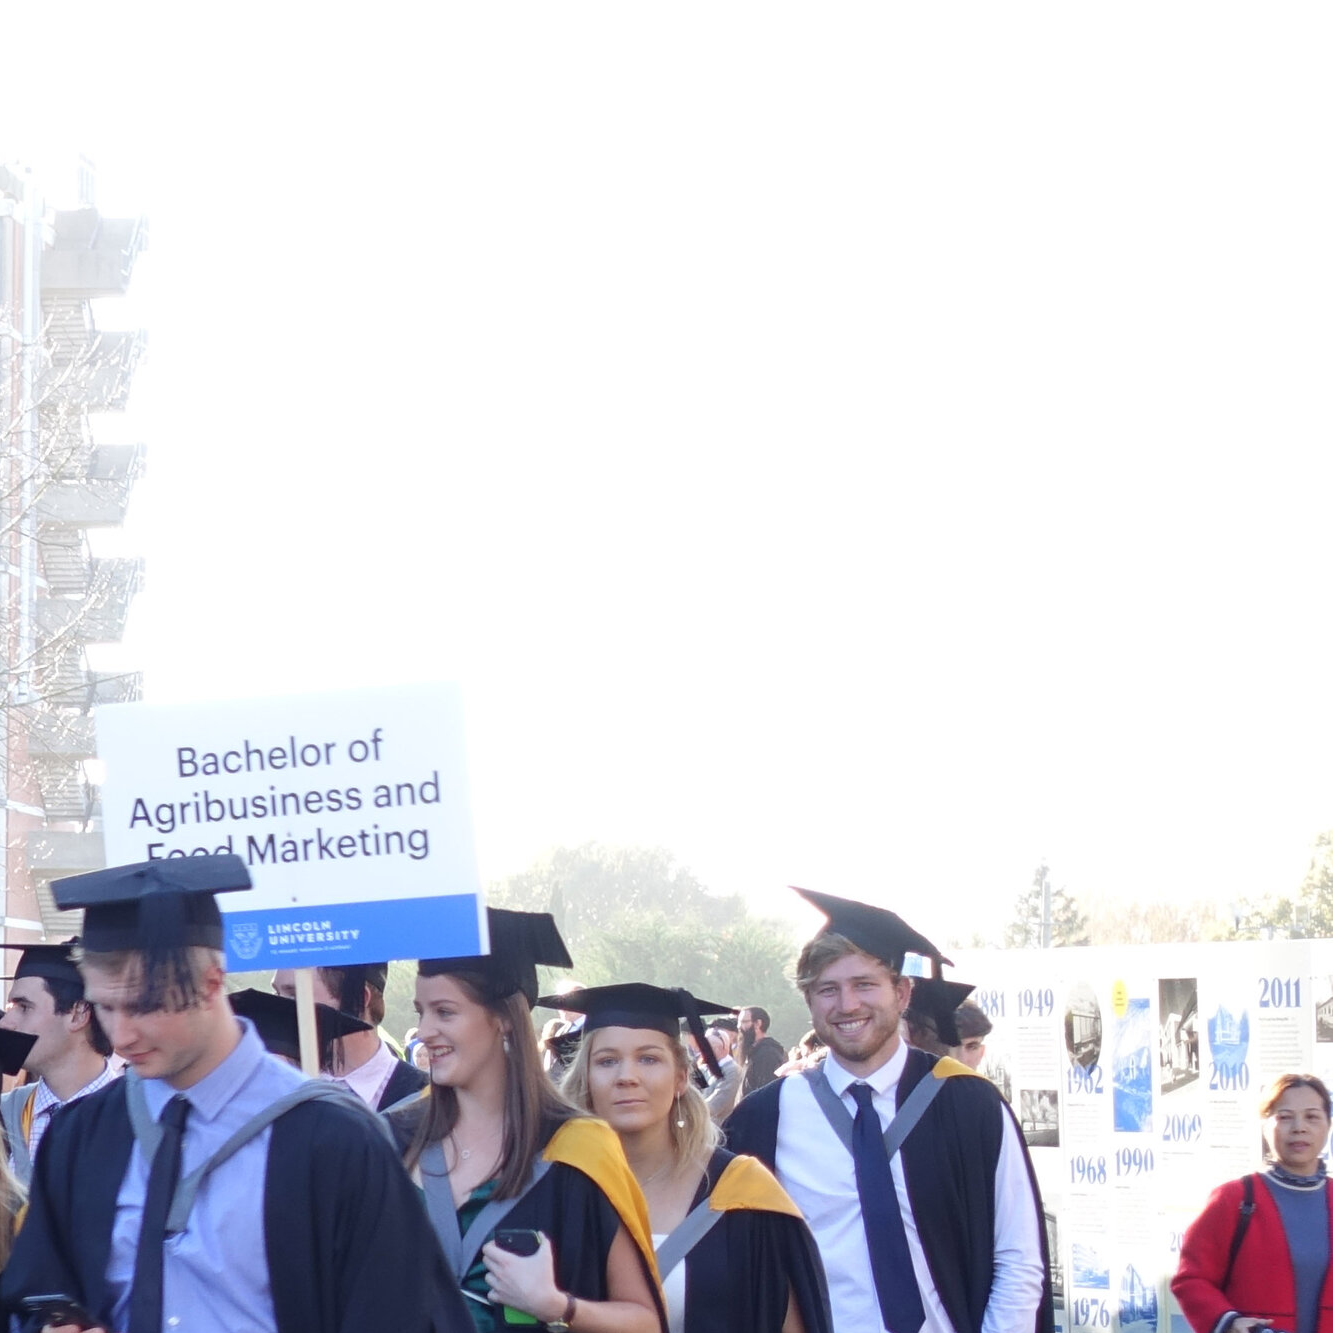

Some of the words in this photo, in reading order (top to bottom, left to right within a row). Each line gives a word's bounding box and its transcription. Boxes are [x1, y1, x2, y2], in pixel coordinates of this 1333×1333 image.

[176, 734, 336, 778] Bachelor
[348, 727, 384, 764] of
[129, 785, 364, 834] Agribusiness
[372, 769, 441, 808] and
[246, 824, 430, 866] Marketing
[268, 920, 331, 934] LINCOLN
[269, 929, 360, 945] UNIVERSITY
[1017, 988, 1055, 1018] 1949
[1258, 976, 1303, 1009] 2011
[1066, 1063, 1105, 1095] 1962
[1208, 1061, 1251, 1092] 2010
[1161, 1113, 1204, 1143] 2009
[1069, 1154, 1108, 1185] 1968
[1115, 1147, 1155, 1177] 1990
[1073, 1297, 1111, 1329] 1976
